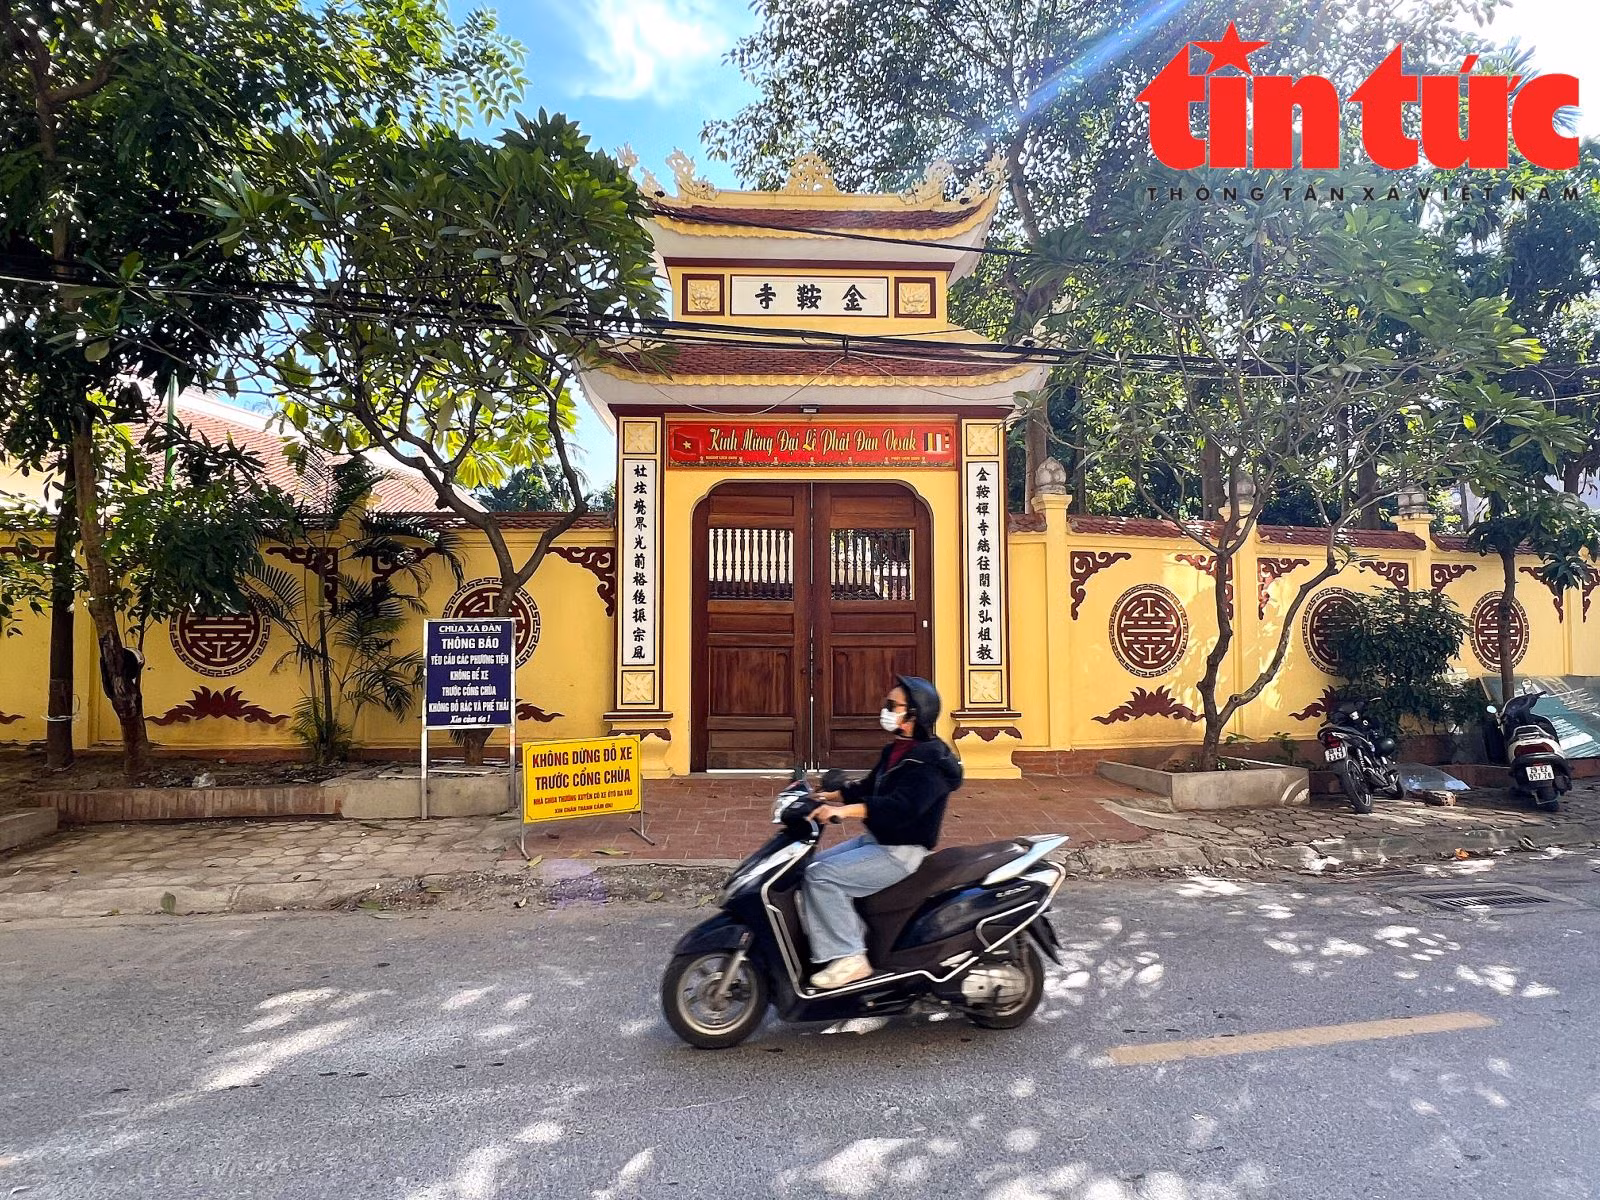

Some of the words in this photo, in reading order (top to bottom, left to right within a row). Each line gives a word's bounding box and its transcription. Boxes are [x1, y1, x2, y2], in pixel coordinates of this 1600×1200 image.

[708, 428, 738, 451] Kính
[741, 428, 773, 456] Mừng
[777, 428, 800, 456] Đại
[820, 428, 850, 455] Phật
[882, 428, 917, 451] Vesak
[438, 623, 465, 633] CHÙA
[481, 623, 502, 632] ĐÀN
[441, 636, 476, 649] THÔNG
[478, 636, 499, 649] BÁO
[430, 653, 443, 665] YÊU
[456, 653, 469, 665] CÁC
[495, 652, 509, 666] TIỆN
[450, 669, 471, 681] KHÔNG
[480, 670, 489, 680] XE
[428, 700, 449, 712] KHÔNG
[450, 715, 462, 724] Xin
[532, 750, 569, 768] KHÔNG
[572, 747, 600, 765] DỪNG
[603, 743, 617, 762] ĐỖ
[620, 746, 633, 761] XE
[535, 772, 569, 790] TRƯỚC
[572, 767, 601, 787] CỔNG
[604, 766, 631, 784] CHÙA
